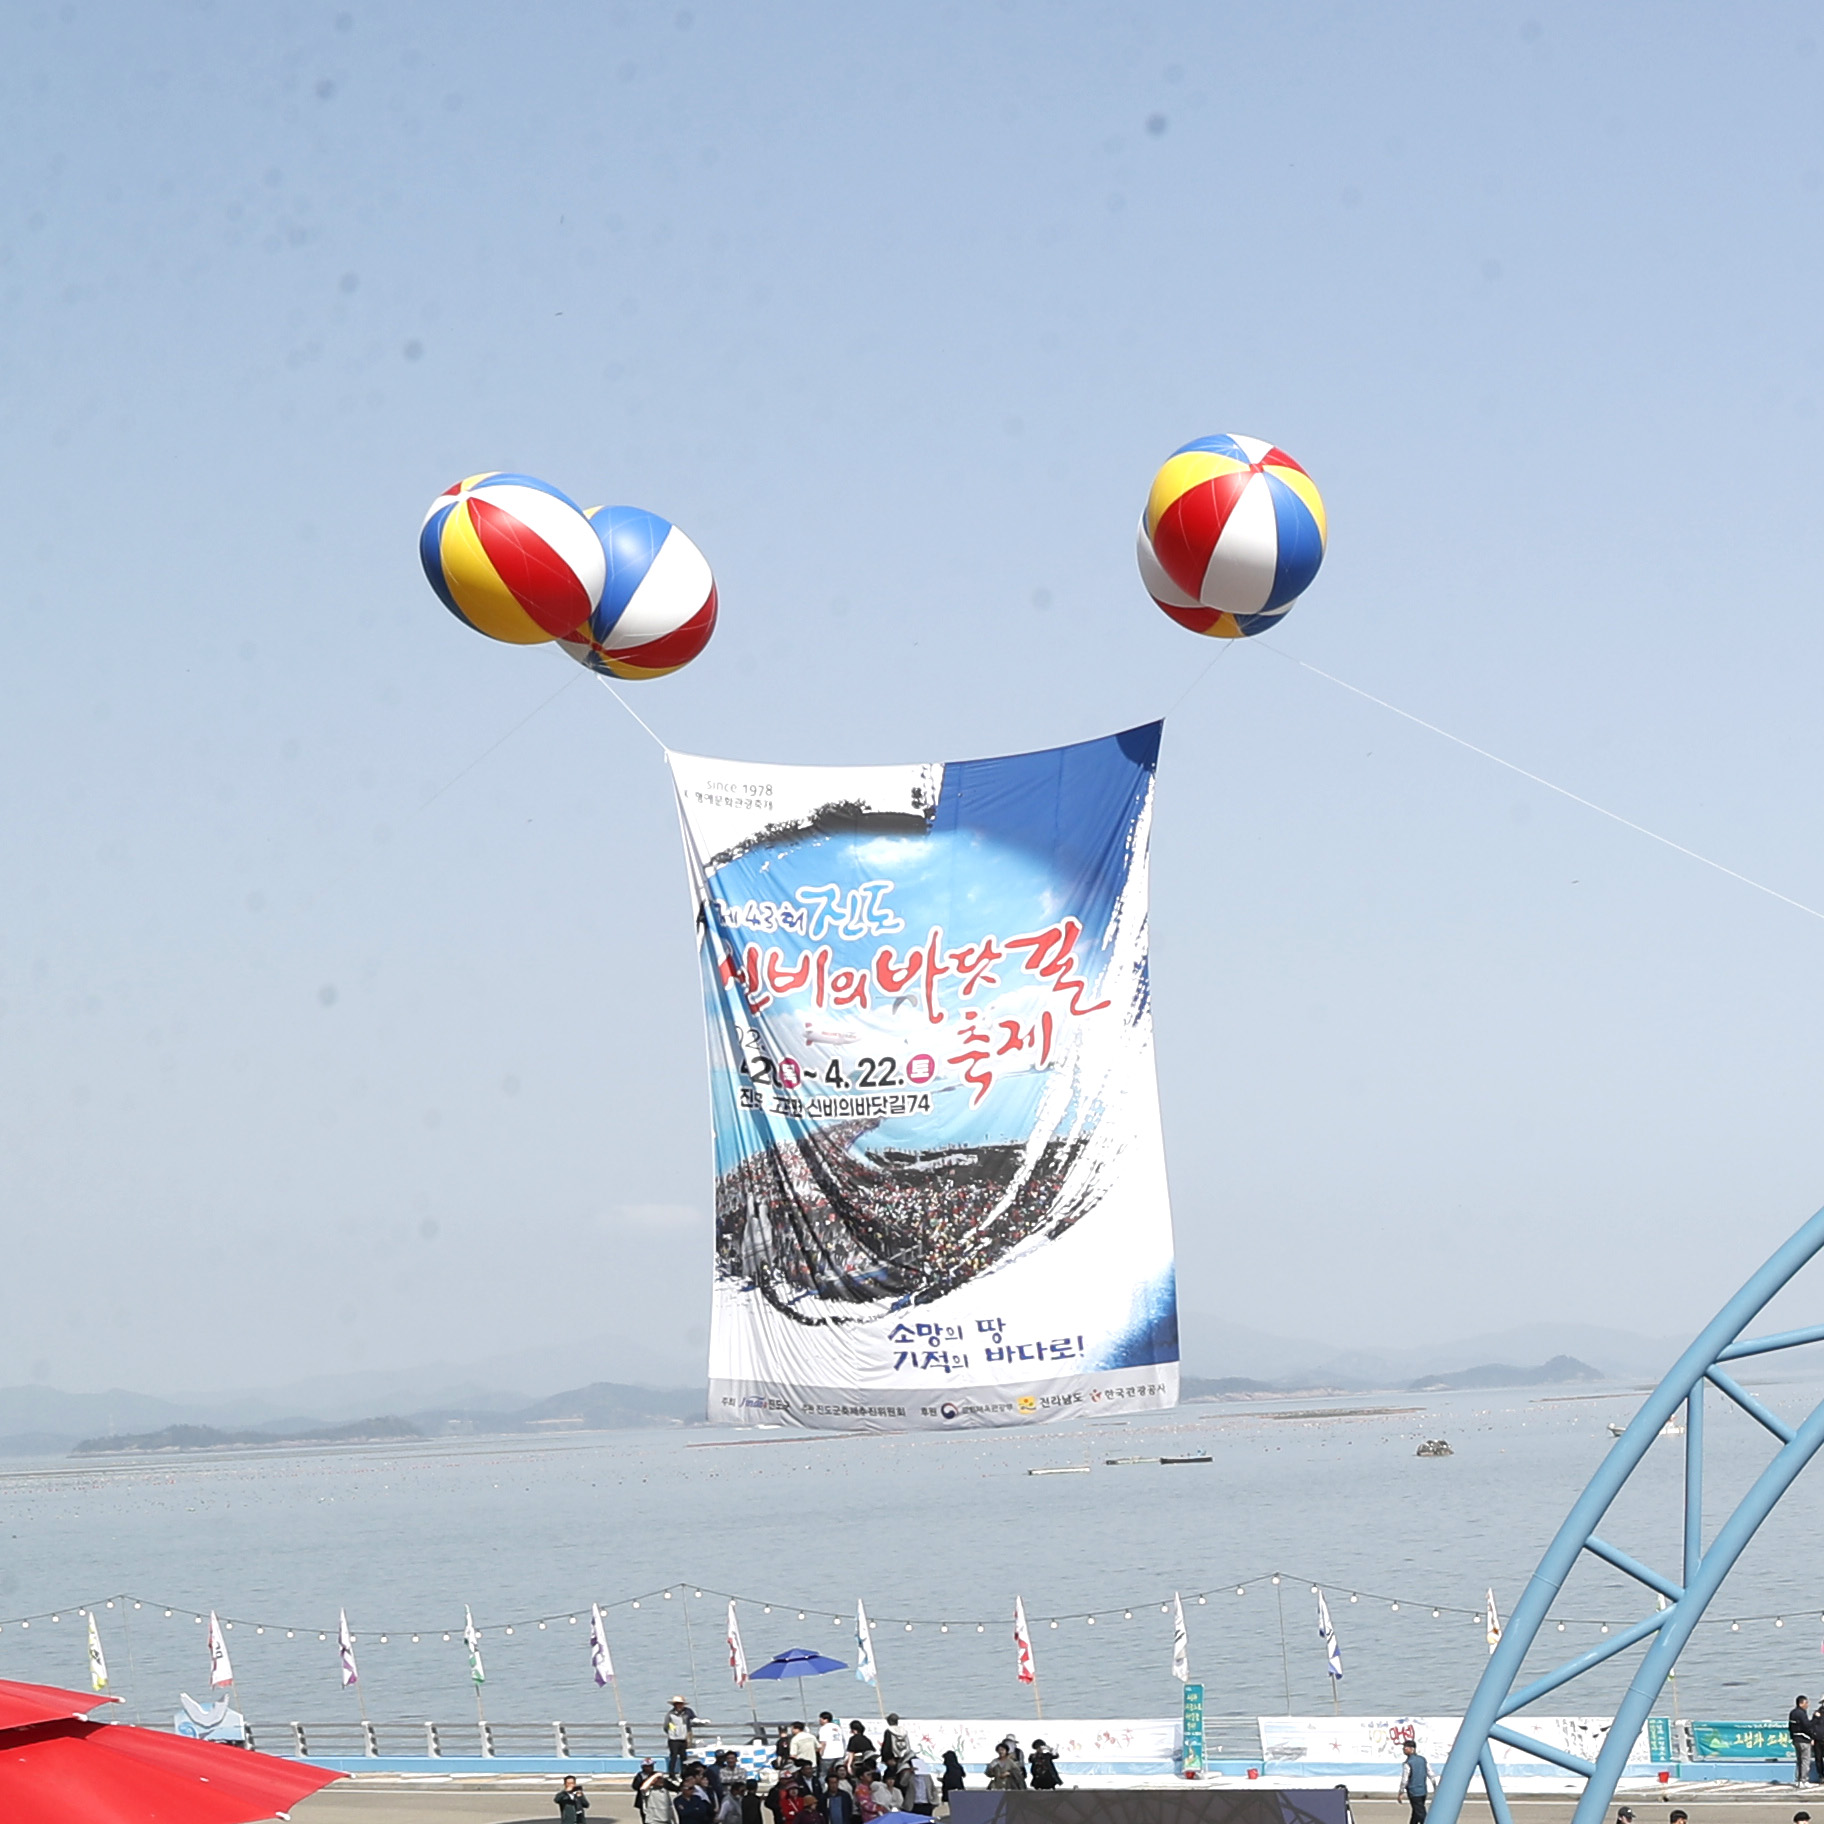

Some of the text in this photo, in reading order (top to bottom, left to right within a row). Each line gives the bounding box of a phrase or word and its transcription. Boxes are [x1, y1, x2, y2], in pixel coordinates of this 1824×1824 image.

[743, 784, 773, 797] 1978
[799, 884, 902, 937] 진도
[948, 1010, 1053, 1105] 축제
[887, 1317, 1006, 1346] 소망의 땅
[984, 1335, 1085, 1366] 바다로!
